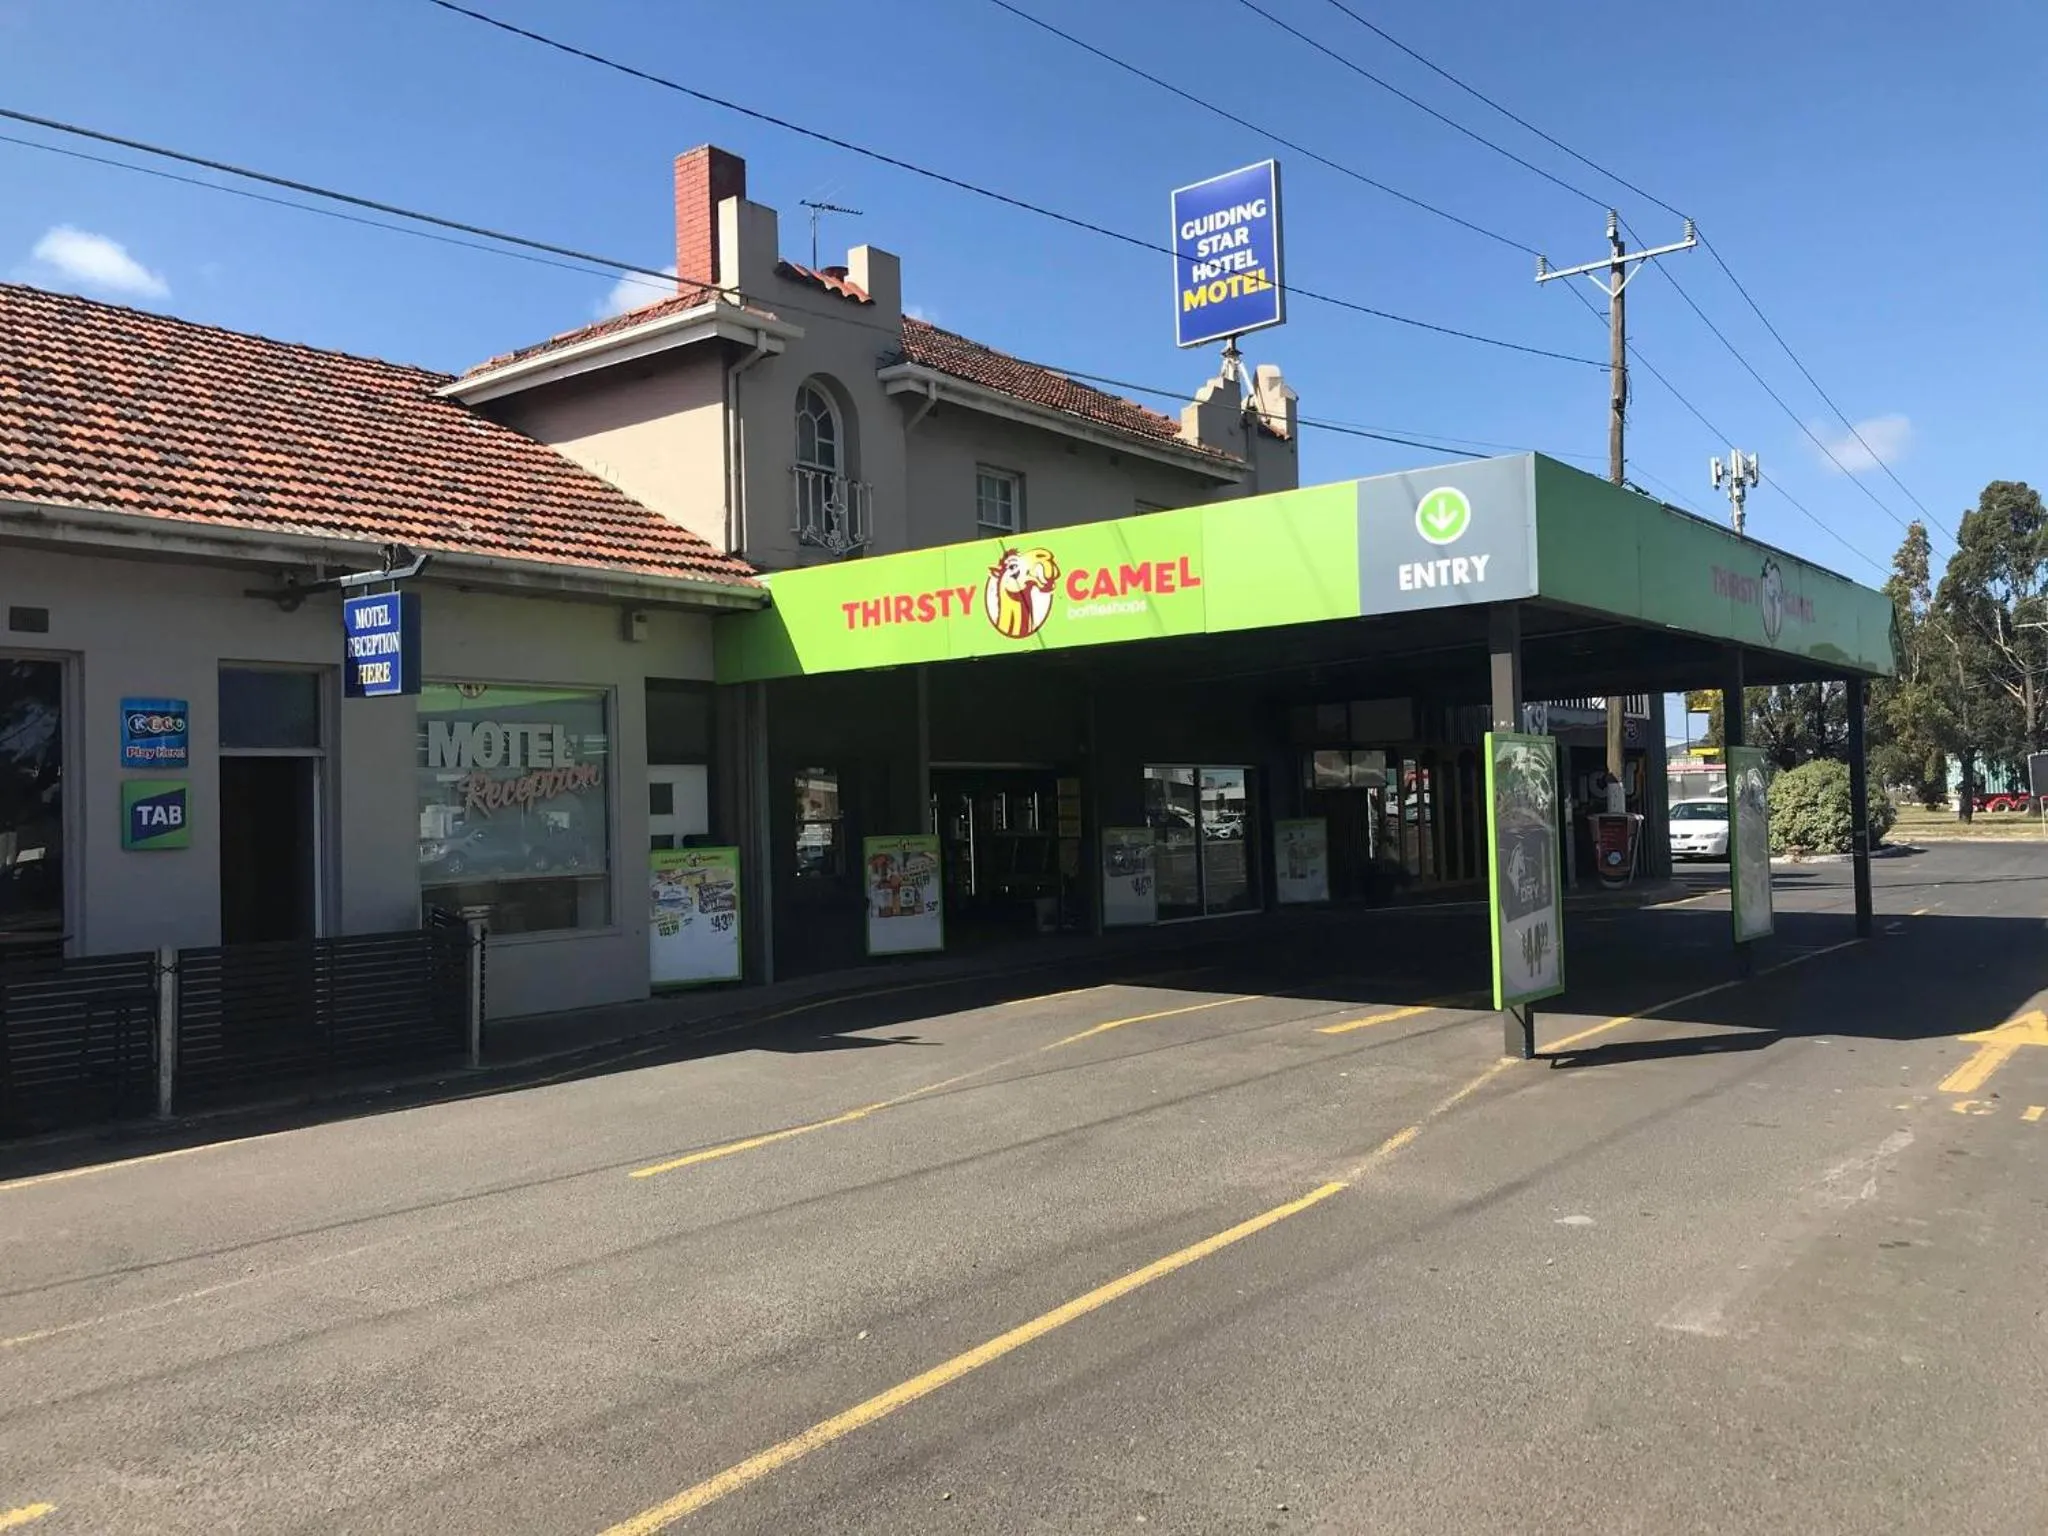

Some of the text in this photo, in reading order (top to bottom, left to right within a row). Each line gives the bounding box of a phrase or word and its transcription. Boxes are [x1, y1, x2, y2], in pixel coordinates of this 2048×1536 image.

[1181, 199, 1267, 240] GUIDING
[1197, 226, 1249, 257] STAR
[1192, 249, 1259, 283] HOTEL
[1183, 268, 1274, 312] MOTEL
[1399, 554, 1490, 590] ENTRY
[841, 556, 1201, 630] THIRSTY CAMEL
[355, 604, 391, 629] MOTEL
[347, 631, 400, 658] RECEPTION
[357, 661, 391, 685] HERE
[126, 746, 155, 760] Play
[427, 720, 576, 769] MOTEL
[457, 762, 600, 821] Reception
[136, 805, 182, 826] TAB
[1520, 883, 1540, 903] DRY
